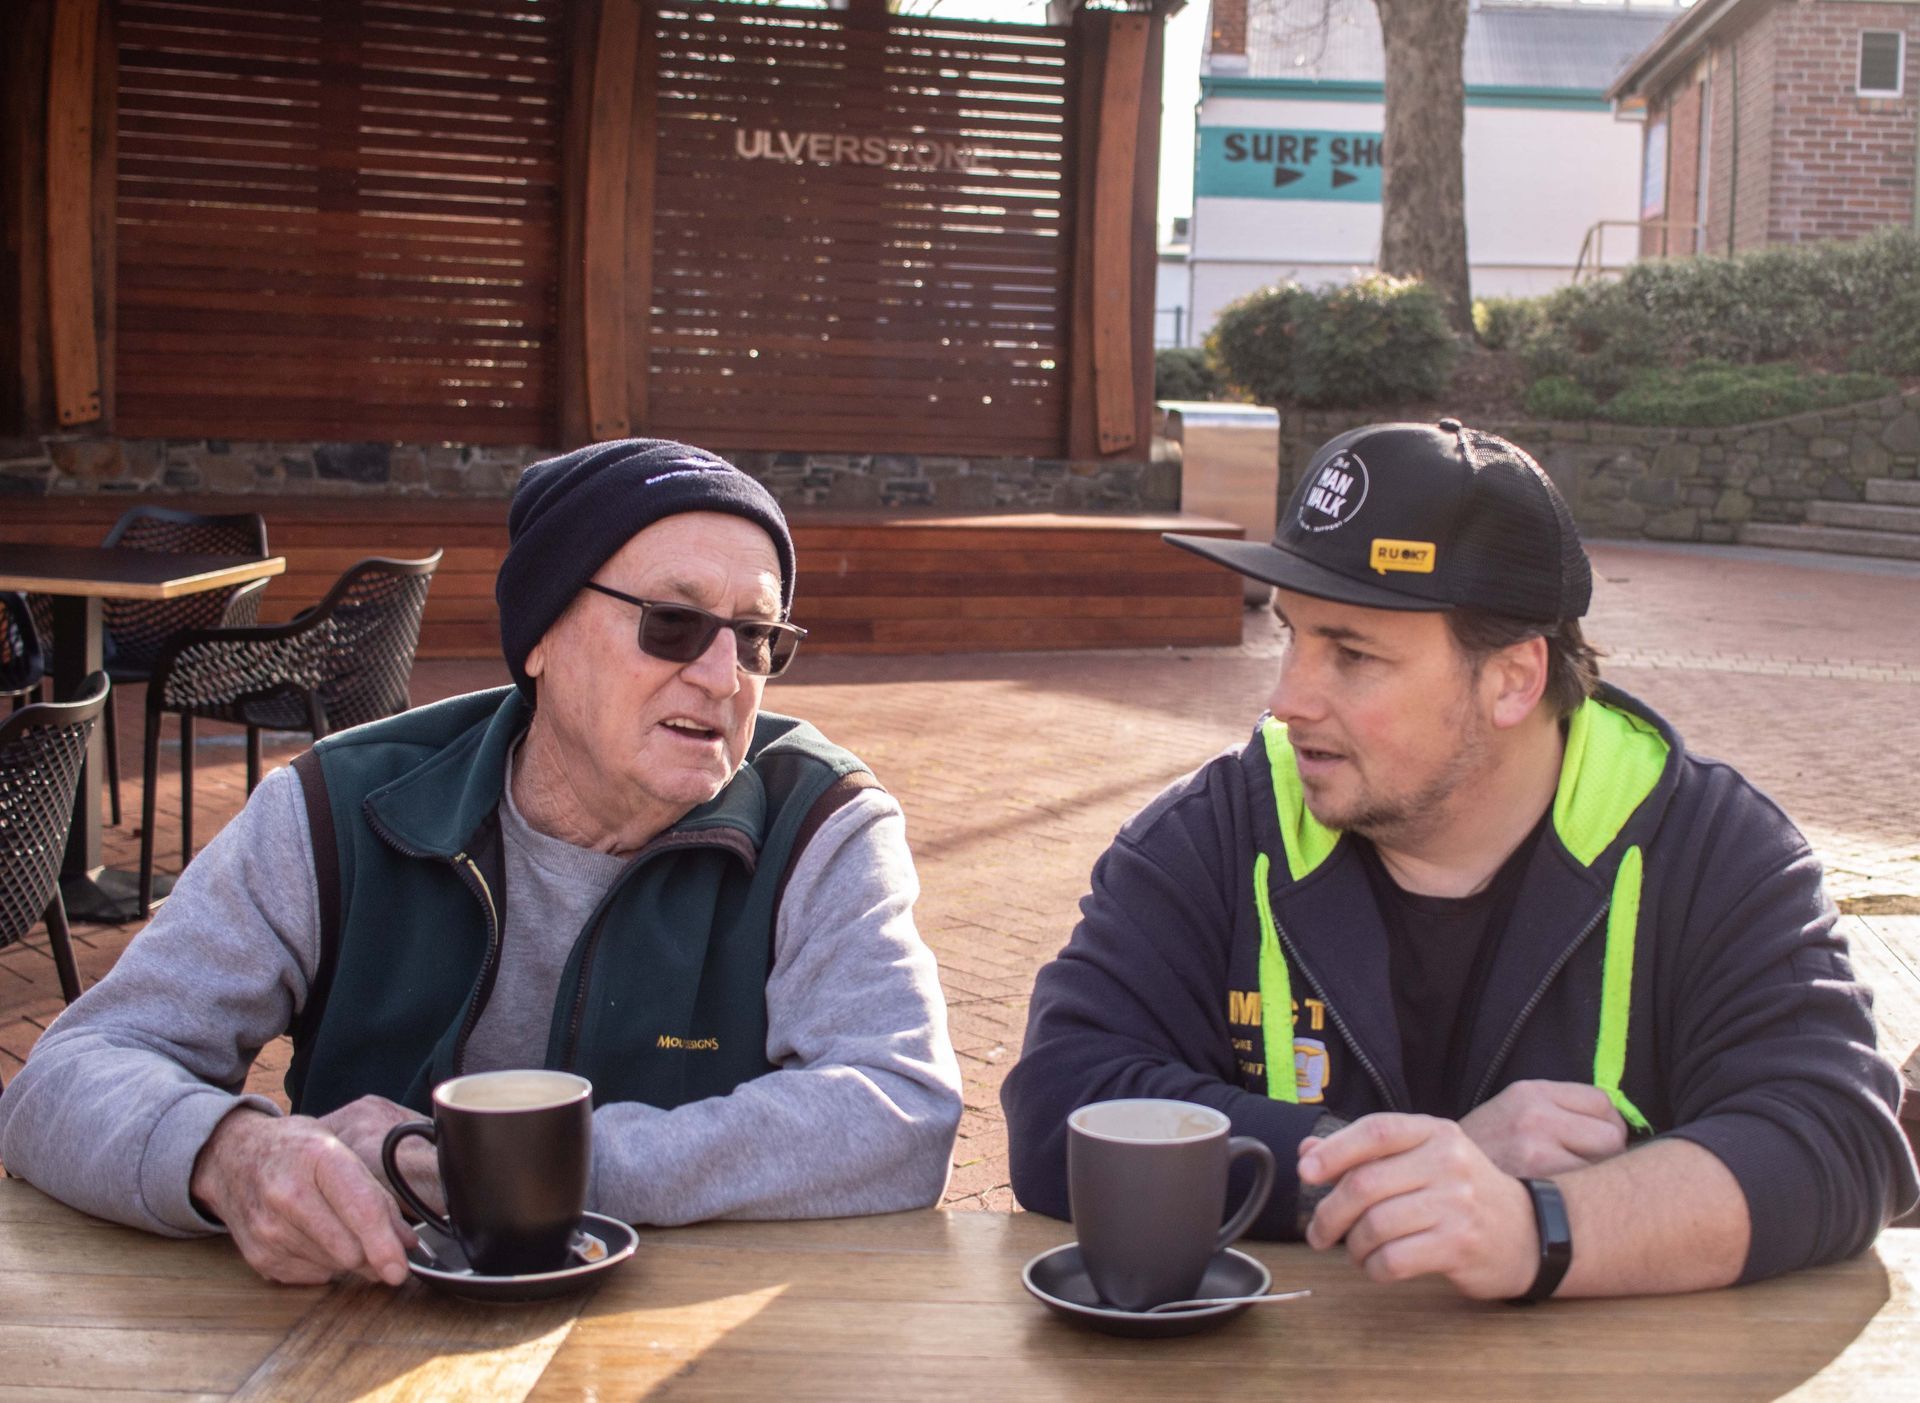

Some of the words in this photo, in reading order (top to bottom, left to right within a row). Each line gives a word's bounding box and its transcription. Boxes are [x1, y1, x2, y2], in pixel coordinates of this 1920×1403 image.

[735, 127, 993, 168] ULVERSTONE
[1224, 133, 1320, 165] SURF
[1317, 467, 1355, 497] MAN
[1306, 486, 1348, 518] WALK
